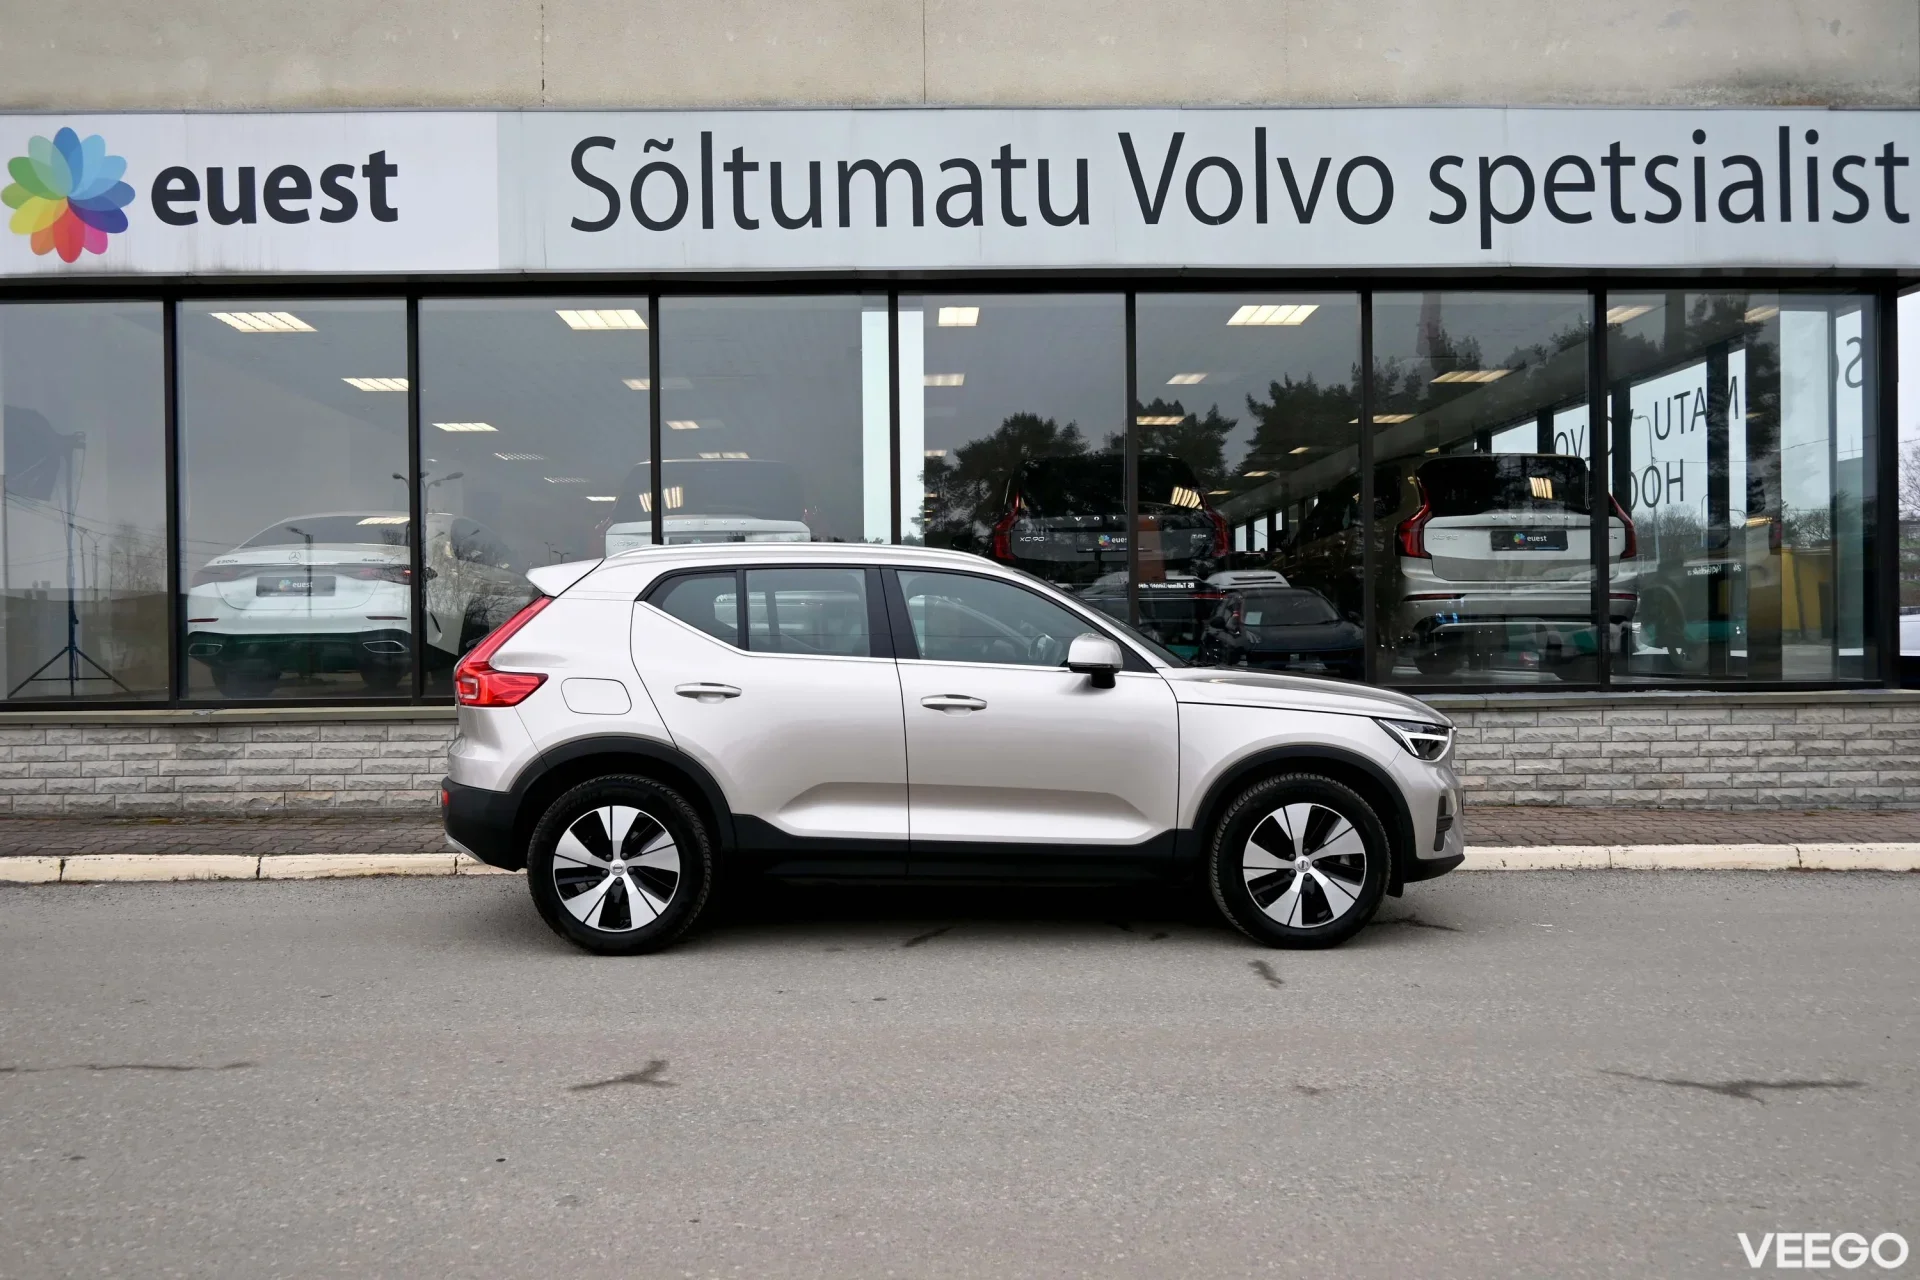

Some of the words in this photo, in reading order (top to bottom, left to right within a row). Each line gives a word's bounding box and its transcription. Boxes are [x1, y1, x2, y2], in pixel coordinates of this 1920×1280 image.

[152, 151, 398, 225] euest
[571, 130, 1089, 232] Sõltumatu
[1118, 127, 1393, 225] Volvo
[1429, 126, 1909, 249] spetsialist
